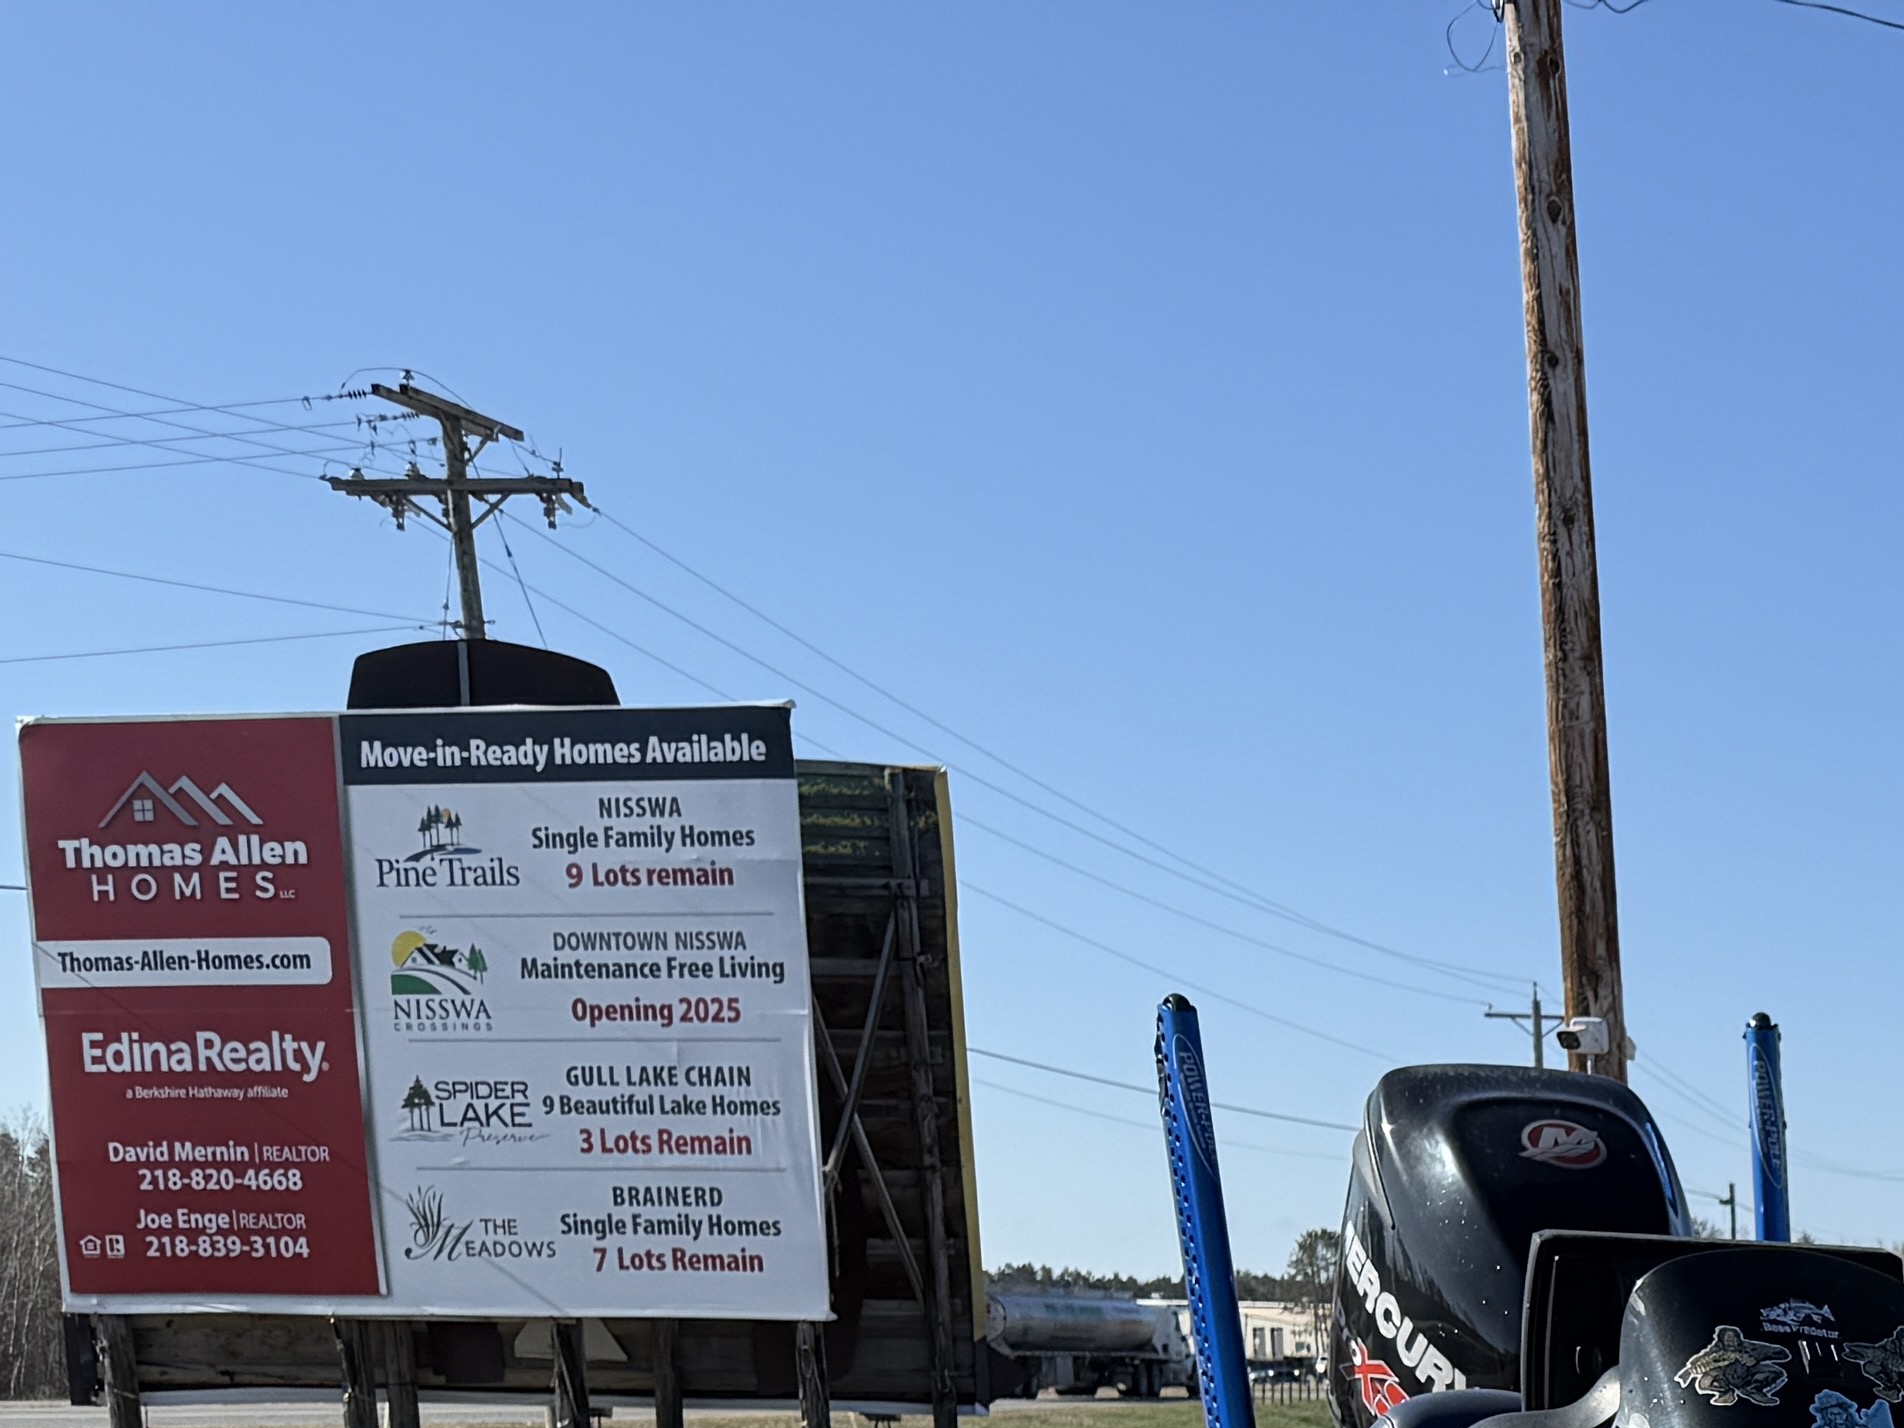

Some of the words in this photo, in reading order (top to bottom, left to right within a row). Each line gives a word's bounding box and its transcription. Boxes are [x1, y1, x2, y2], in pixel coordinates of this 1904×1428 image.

[361, 737, 548, 771] Move-in-Ready
[554, 737, 641, 767] Homes
[645, 733, 767, 764] Available
[599, 797, 682, 818] NISSWA
[58, 838, 202, 869] Thomas
[210, 834, 308, 866] Allen
[532, 826, 599, 854] Single
[604, 825, 675, 853] Family
[680, 825, 755, 847] Homes
[375, 857, 436, 888] Pine
[440, 856, 520, 887] Trails
[566, 863, 583, 888] 9
[592, 863, 641, 887] Lots
[647, 861, 734, 886] remain
[91, 871, 275, 901] HOMES
[280, 889, 296, 898] LLC
[553, 931, 668, 951] DOWNTOWN
[674, 931, 746, 951] NISSWA
[58, 950, 312, 973] Thomas-Allen-Homes.com
[521, 956, 662, 980] Maintenance
[667, 957, 714, 979] Free
[719, 956, 785, 984] Living
[394, 999, 492, 1020] NISSWA
[571, 997, 673, 1027] Opening
[679, 997, 742, 1023] 2025
[394, 1022, 493, 1031] CROSSINGS
[82, 1032, 193, 1073] Edina
[566, 1065, 619, 1087] GULL
[625, 1065, 679, 1087] LAKE
[685, 1065, 751, 1087] CHAIN
[126, 1089, 134, 1099] a
[135, 1086, 187, 1099] Berkshire
[189, 1085, 244, 1101] Hathaway
[247, 1085, 289, 1098] affiliate
[434, 1081, 528, 1100] SPIDER
[439, 1103, 533, 1127] LAKE
[542, 1095, 554, 1116] 9
[559, 1093, 654, 1116] Beautiful
[659, 1094, 707, 1116] Lake
[712, 1094, 781, 1116] Homes
[108, 1141, 169, 1162] David
[174, 1141, 249, 1162] Mernin
[263, 1145, 330, 1162] REALTOR
[579, 1128, 594, 1154] 3
[600, 1128, 652, 1154] Lots
[657, 1128, 752, 1155] Remain
[138, 1168, 302, 1191] 218-820-4668
[612, 1186, 723, 1207] BRAINERD
[136, 1210, 173, 1230] Joe
[177, 1209, 230, 1233] Enge
[240, 1213, 306, 1229] REALTOR
[480, 1218, 518, 1236] THE
[560, 1213, 626, 1240] Single
[632, 1212, 703, 1240] Family
[708, 1213, 782, 1236] Homes
[146, 1236, 310, 1259] 218-839-3104
[405, 1220, 556, 1261] MEADOWS
[593, 1248, 607, 1272] 7
[617, 1247, 666, 1271] Lots
[672, 1246, 764, 1273] Remain
